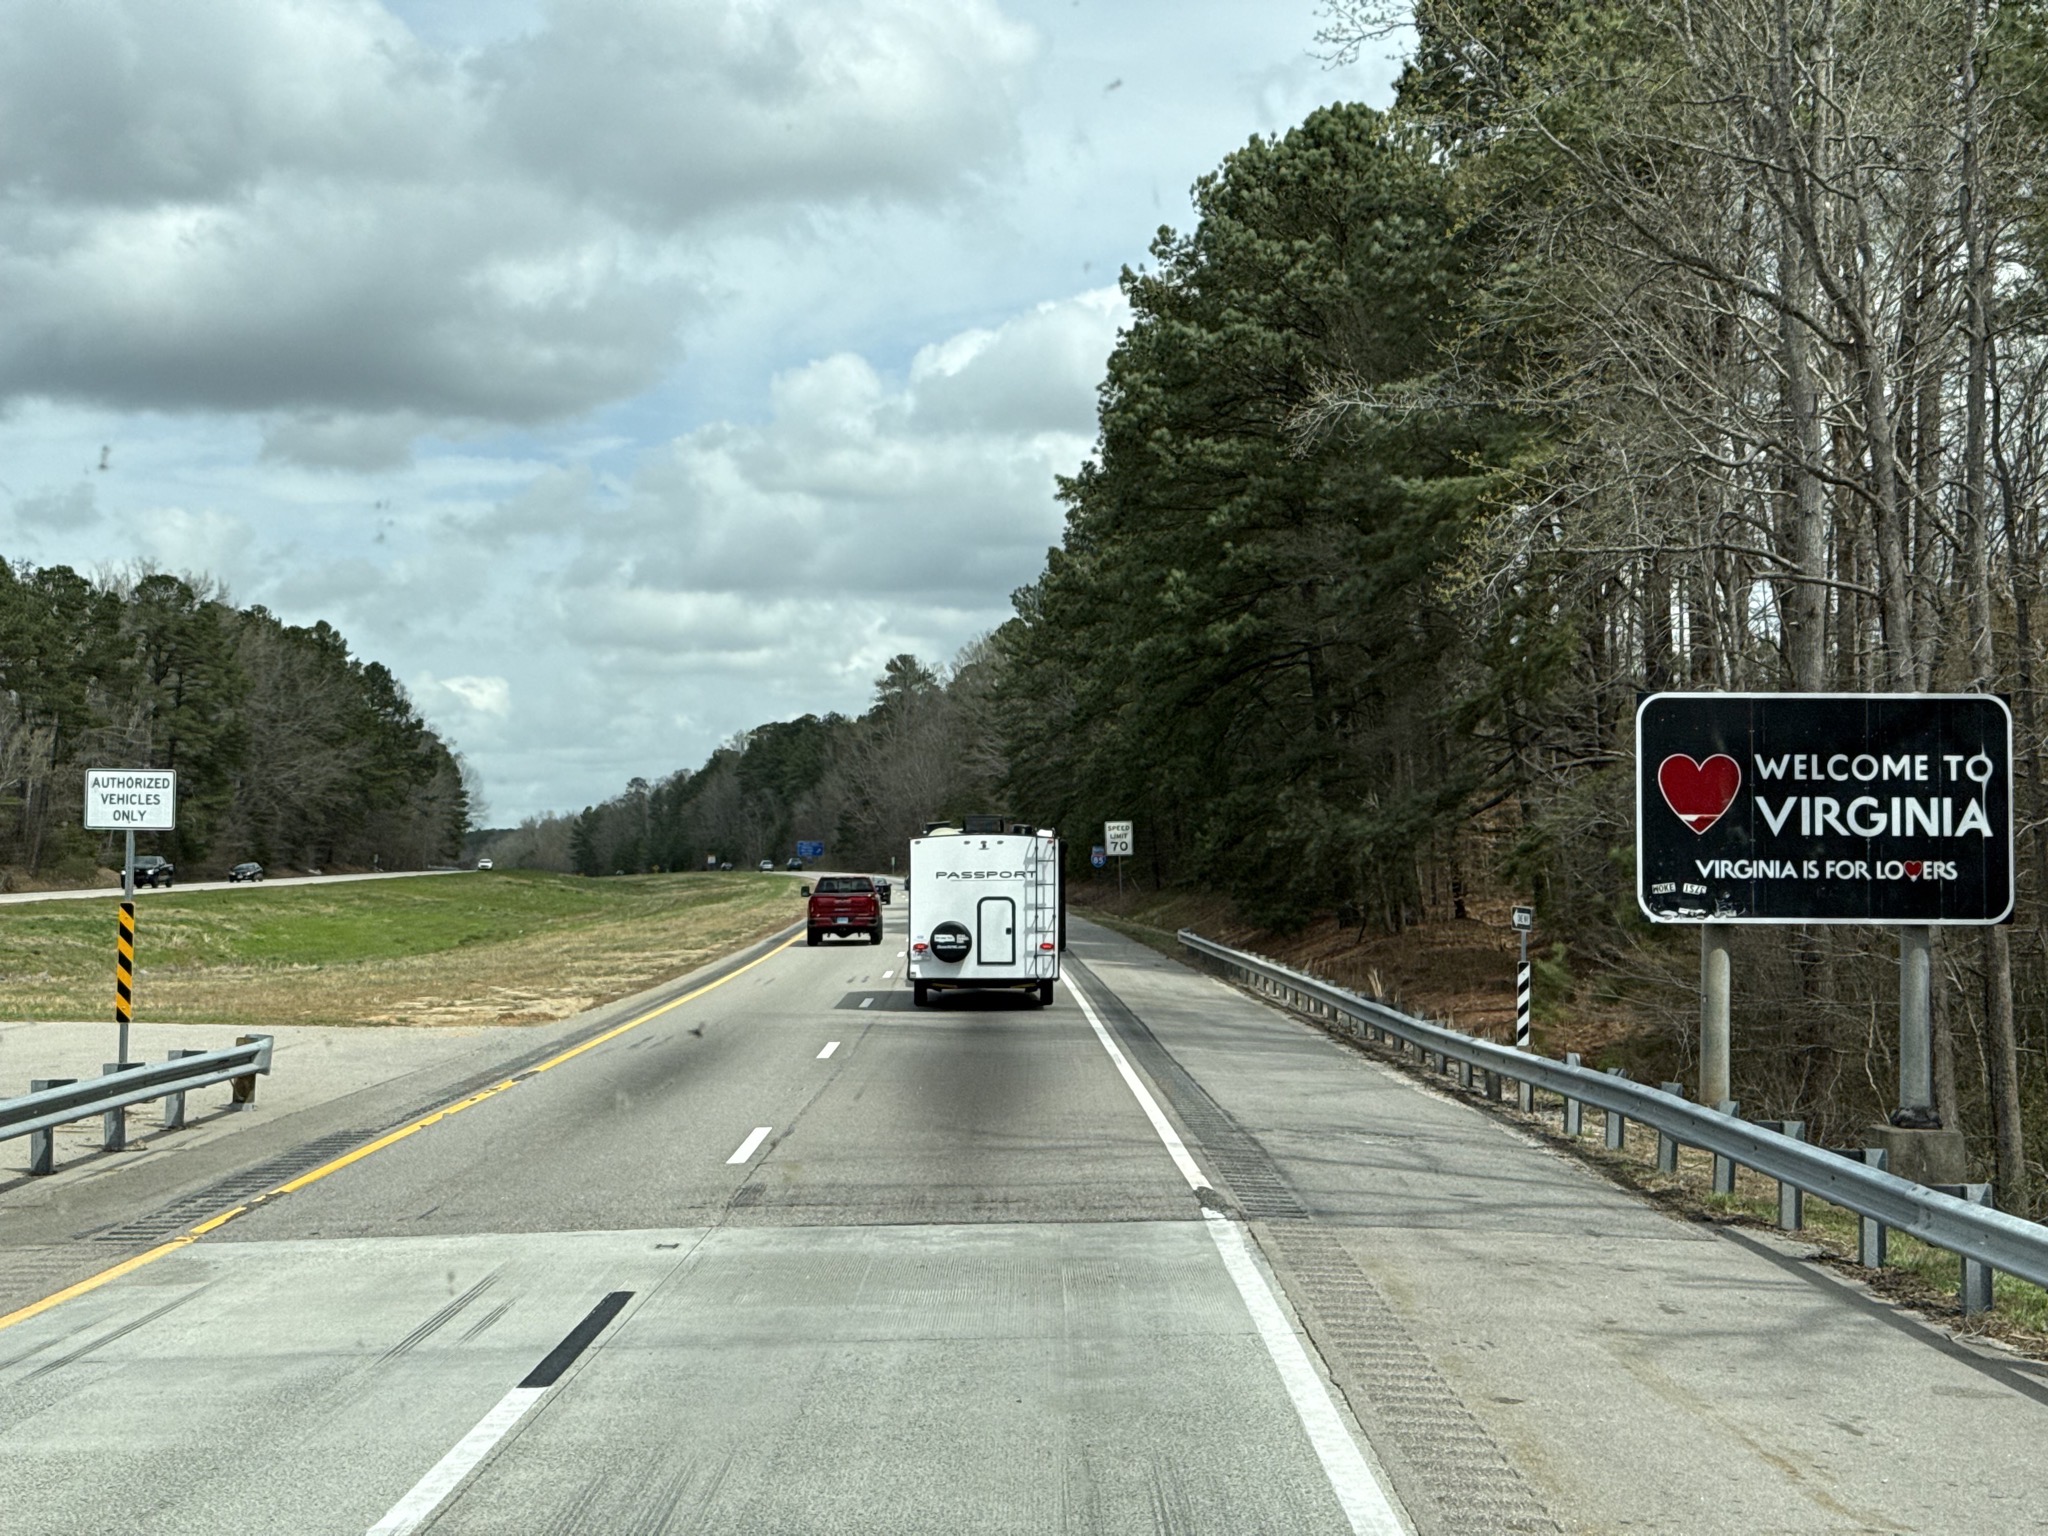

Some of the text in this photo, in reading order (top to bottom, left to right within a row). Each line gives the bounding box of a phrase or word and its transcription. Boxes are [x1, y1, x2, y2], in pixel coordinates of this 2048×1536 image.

[1754, 753, 1993, 782] WELCOME TO
[92, 777, 170, 789] AUTHORIZED
[101, 793, 161, 805] VEHICLES
[113, 810, 147, 821] ONLY
[1754, 796, 1994, 838] VIRGINIA
[1110, 841, 1129, 852] 70
[936, 870, 1037, 879] PASSPORT
[1695, 860, 1799, 880] VIRGINIA
[1803, 860, 1819, 880] IS
[1826, 860, 1872, 880] FOR
